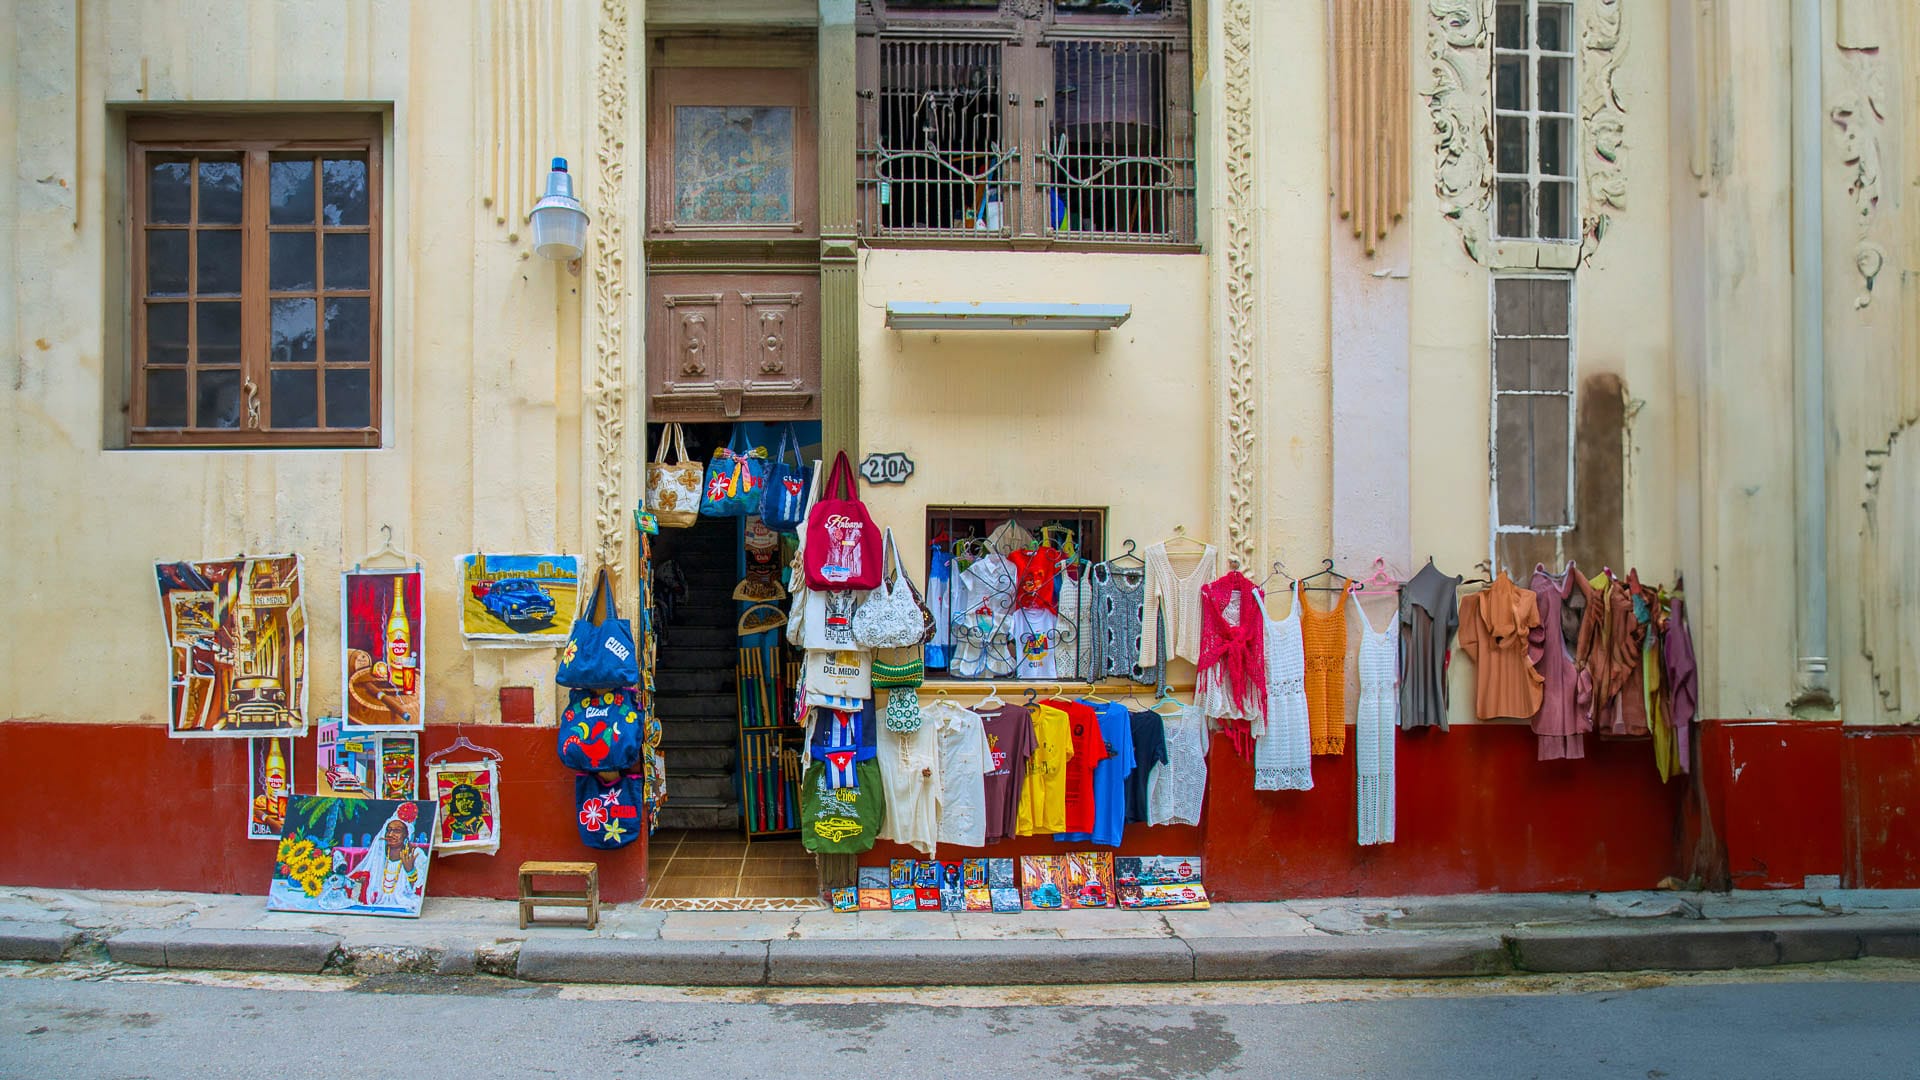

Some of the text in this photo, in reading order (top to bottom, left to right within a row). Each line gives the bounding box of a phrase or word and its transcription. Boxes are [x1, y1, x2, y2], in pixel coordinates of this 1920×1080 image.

[869, 460, 908, 477] 210A
[824, 514, 863, 528] Habana
[604, 636, 630, 661] CUBA
[823, 664, 860, 677] DEL MEDIO
[252, 822, 272, 834] CUBA
